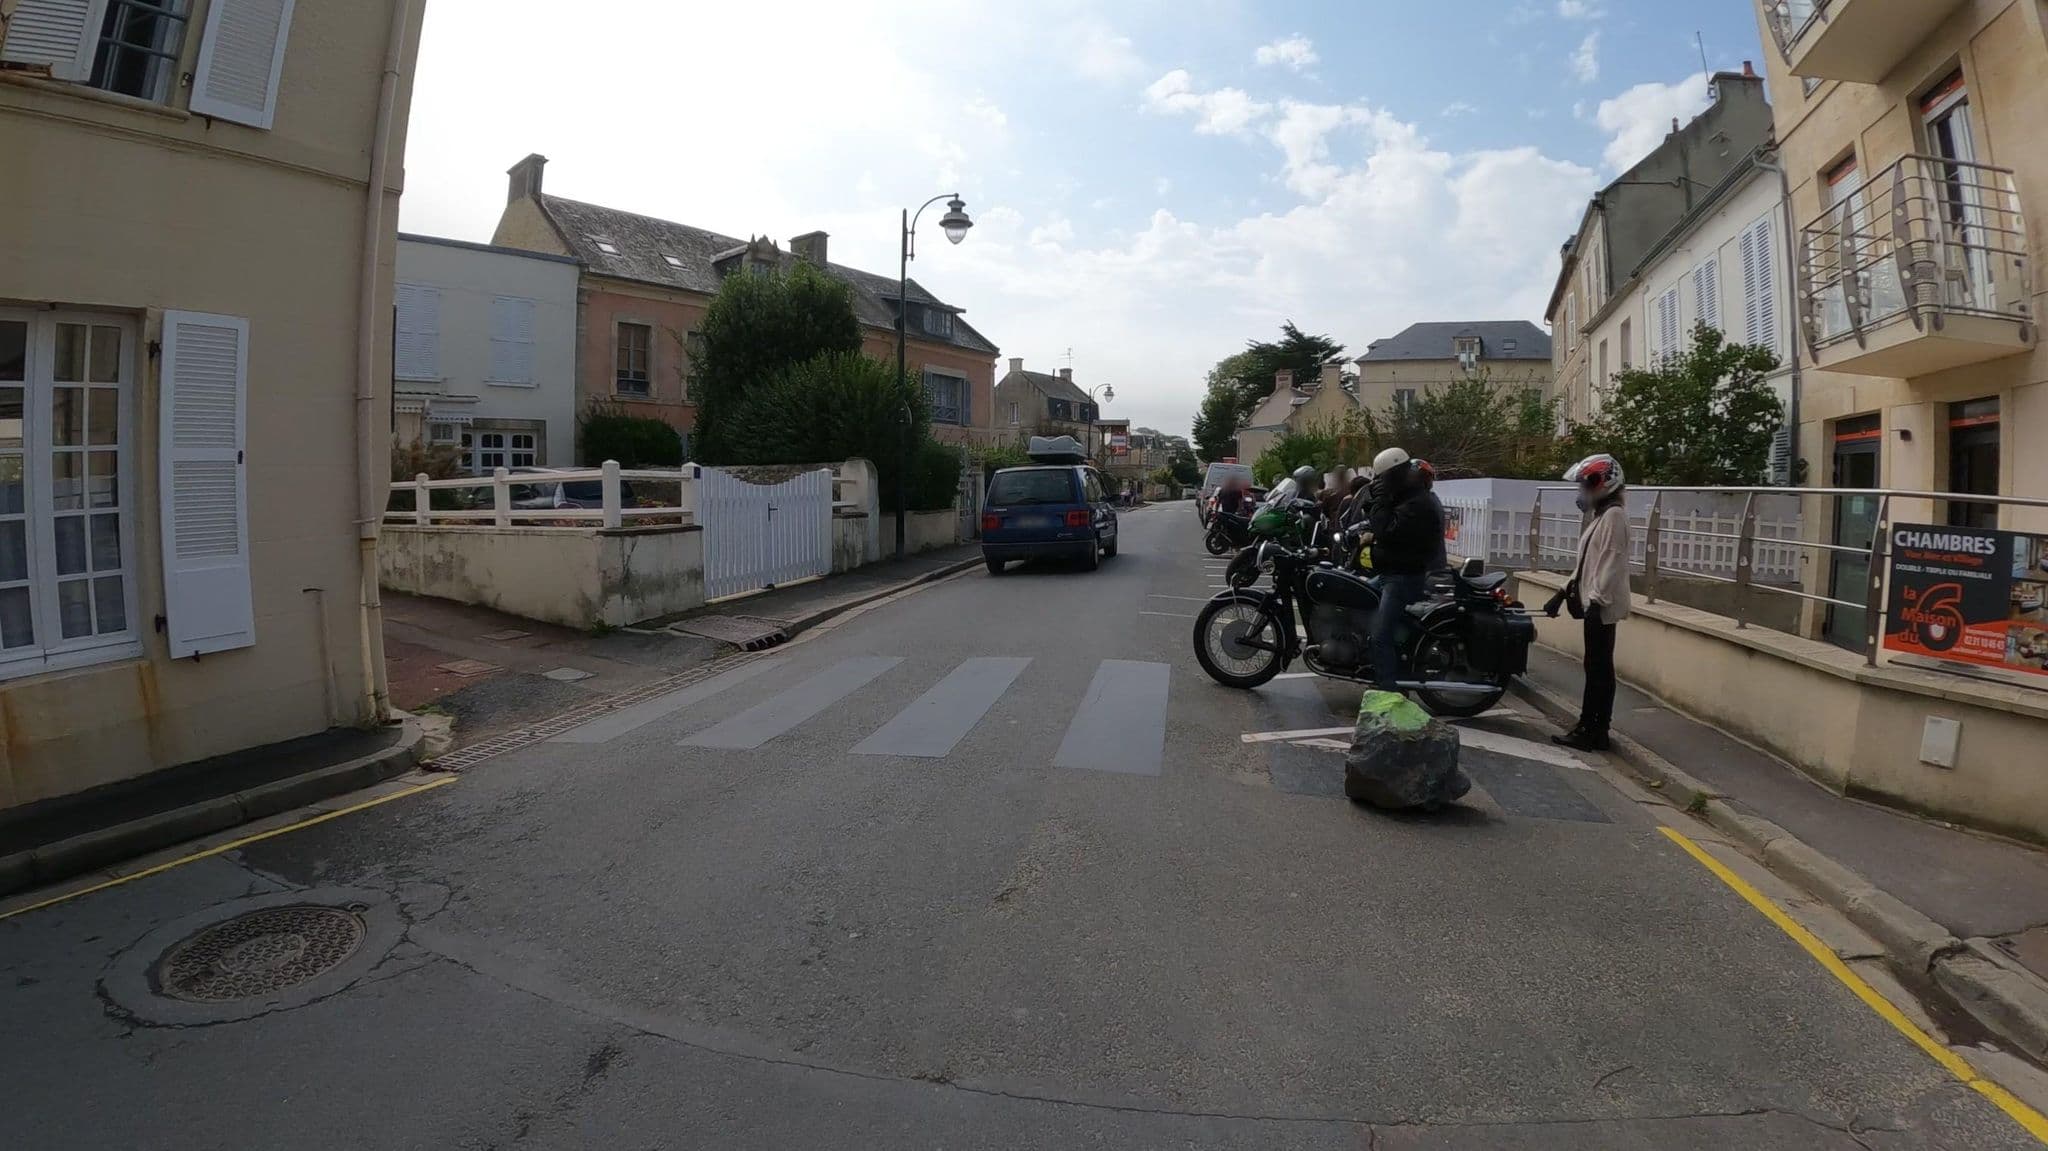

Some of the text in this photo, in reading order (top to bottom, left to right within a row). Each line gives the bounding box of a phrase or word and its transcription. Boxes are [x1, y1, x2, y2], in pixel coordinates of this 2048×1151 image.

[1894, 530, 1996, 555] CHAMBRES
[1895, 563, 1921, 573] DOUBLE
[1926, 566, 1947, 575] TRIPLE
[1904, 585, 1916, 600] la
[1902, 607, 1956, 628] Maison
[1913, 583, 1964, 651] 6
[1899, 629, 1919, 643] du
